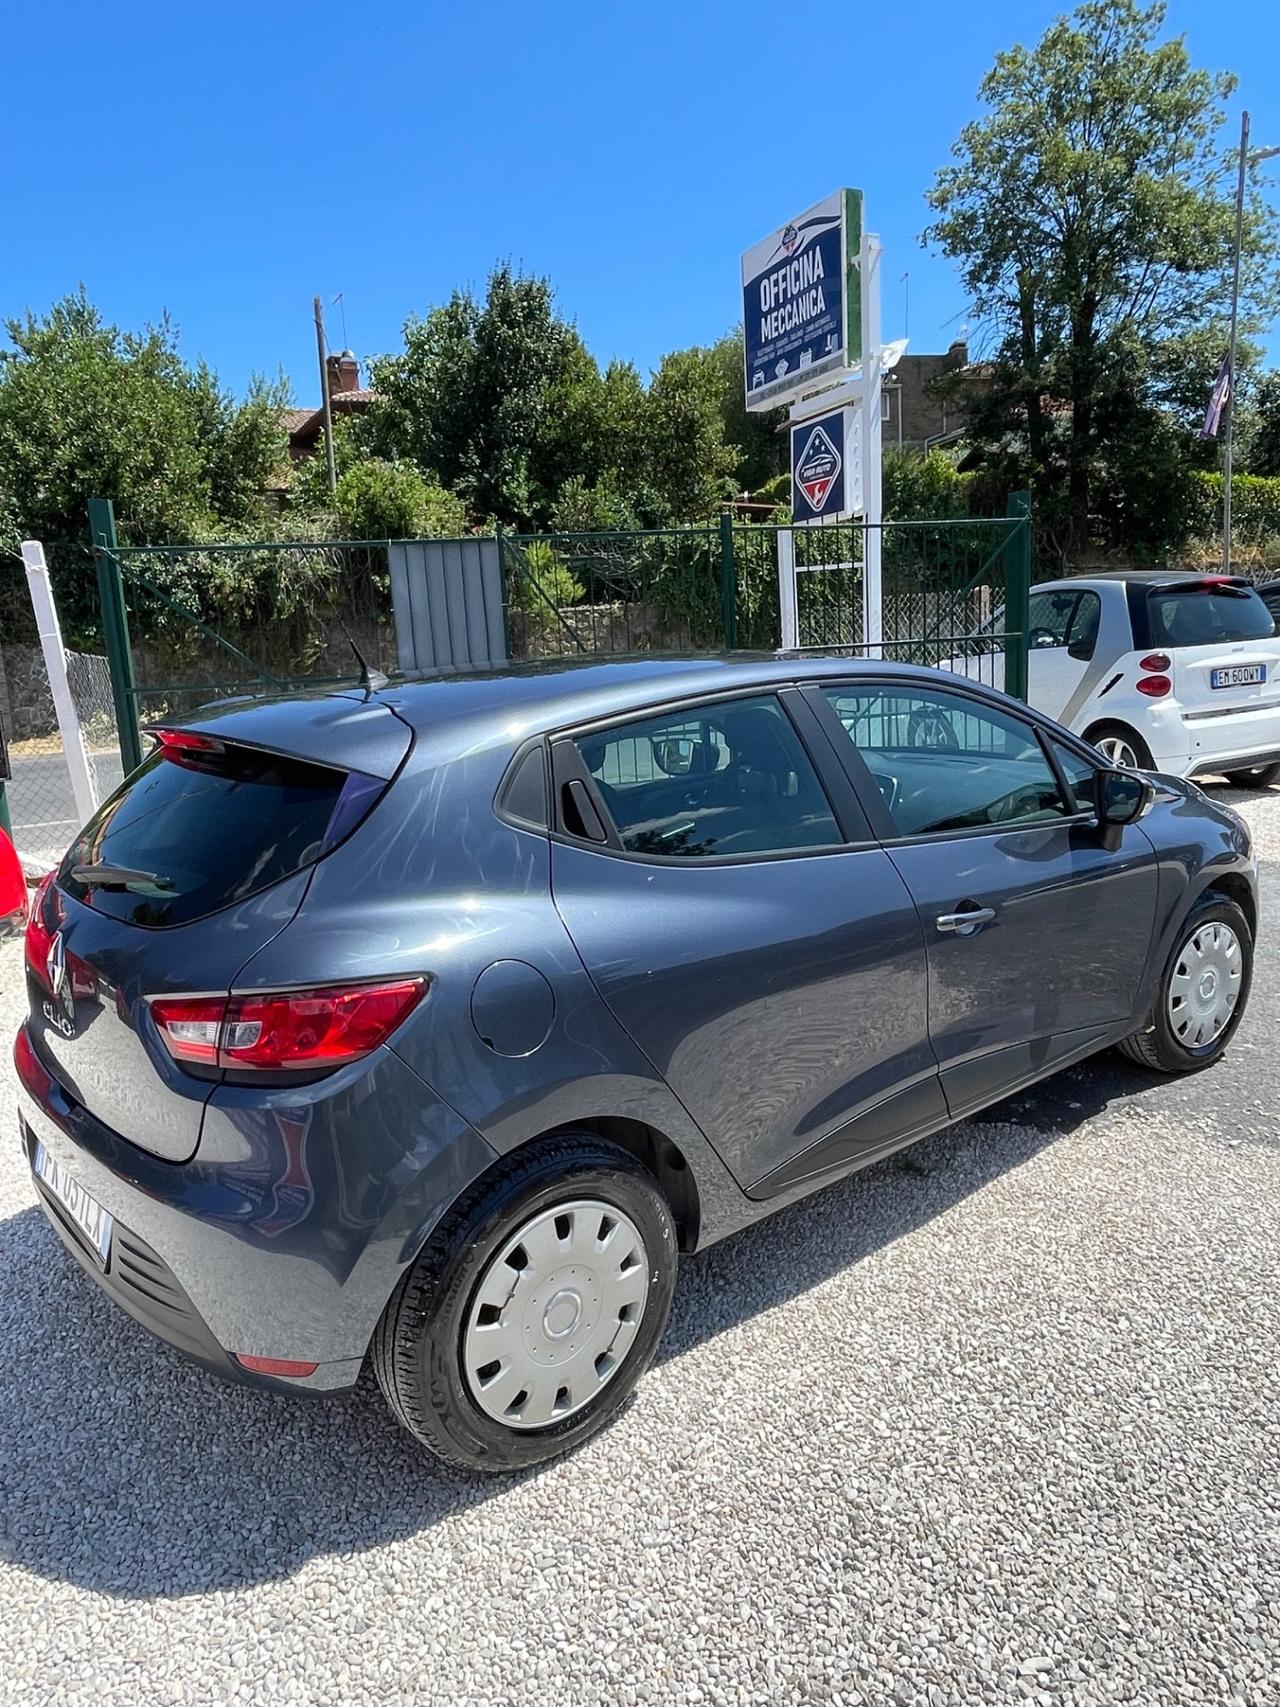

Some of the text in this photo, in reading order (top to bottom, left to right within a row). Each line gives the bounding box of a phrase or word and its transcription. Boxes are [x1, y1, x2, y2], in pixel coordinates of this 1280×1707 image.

[759, 245, 825, 313] OFFICINA
[760, 285, 826, 344] MECCANICA
[1218, 668, 1259, 685] EM 600WY
